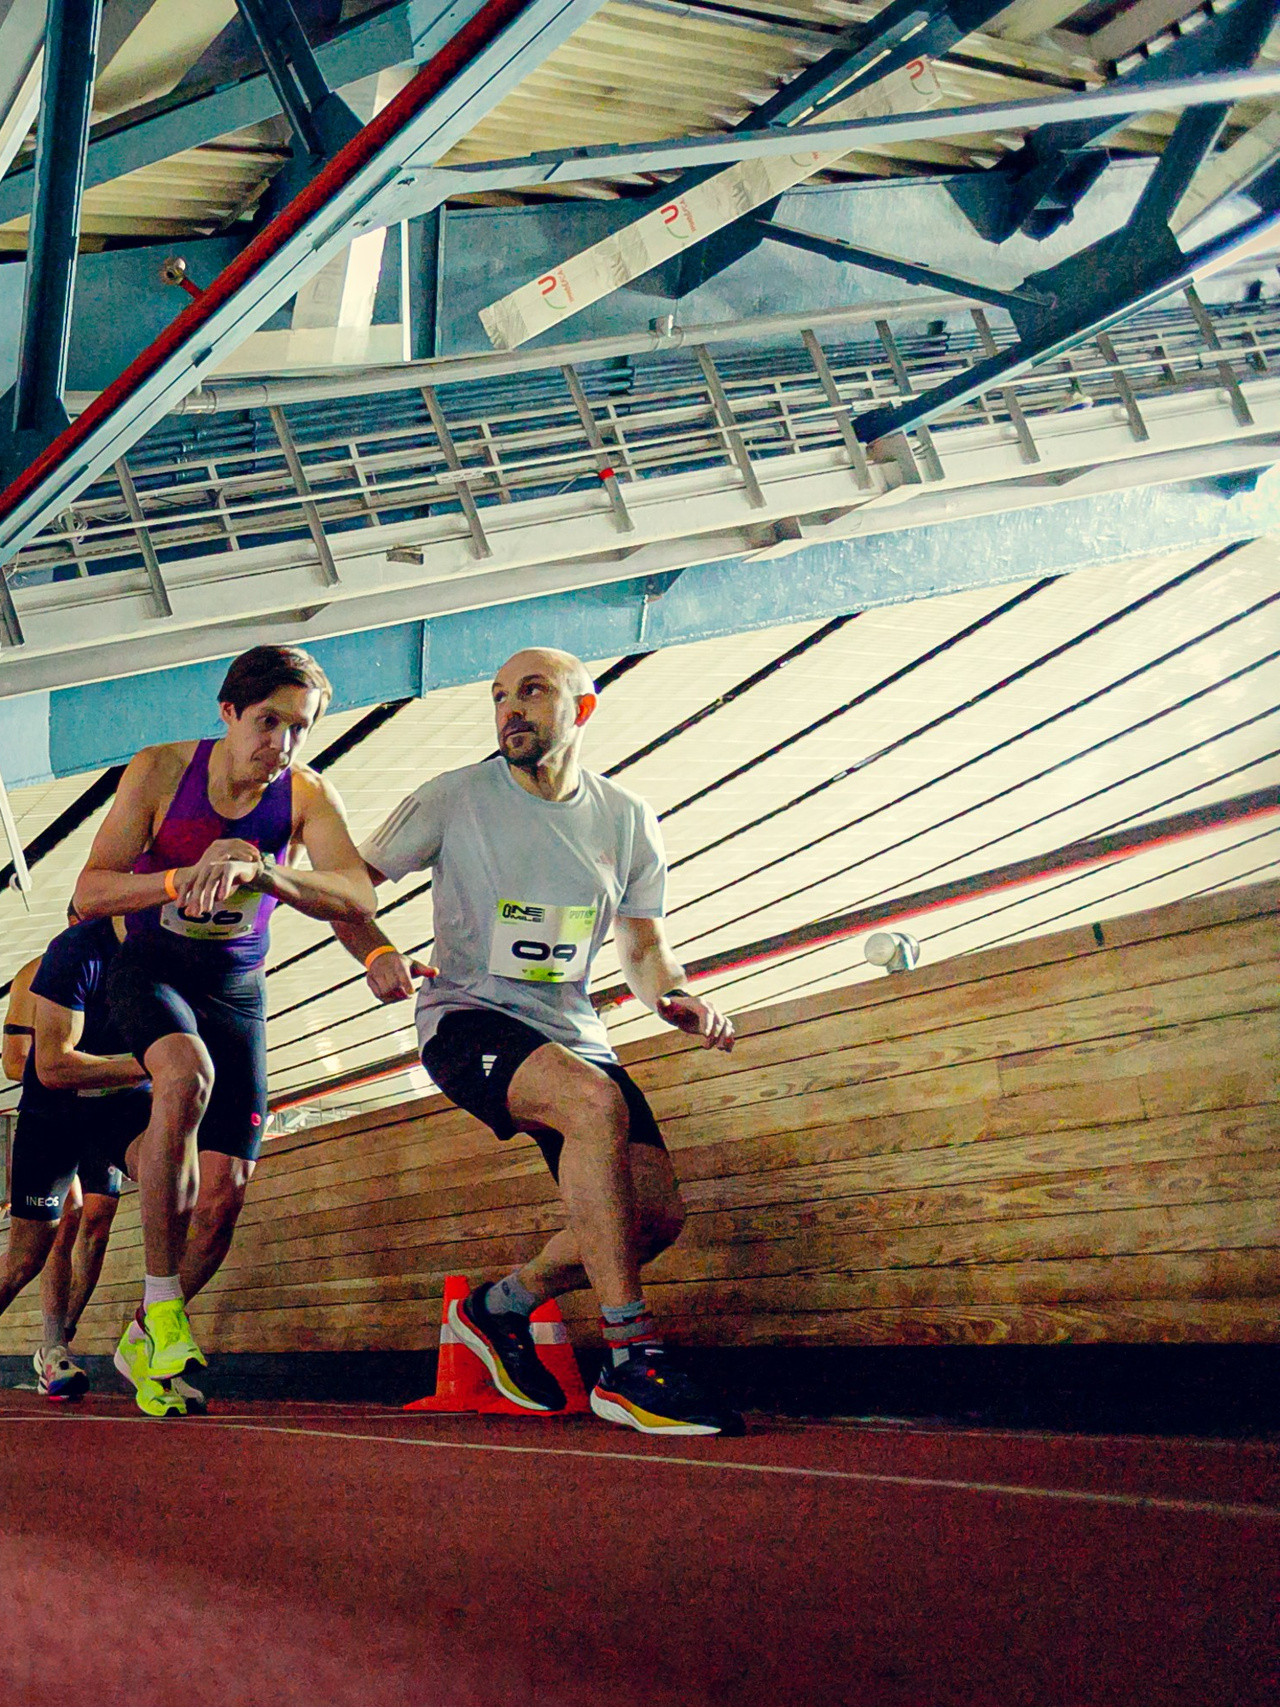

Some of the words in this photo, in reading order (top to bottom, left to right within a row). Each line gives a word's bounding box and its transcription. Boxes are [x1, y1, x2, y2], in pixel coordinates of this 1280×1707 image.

[502, 903, 543, 919] ONE
[511, 940, 577, 962] 09
[26, 1195, 59, 1207] INEOS
